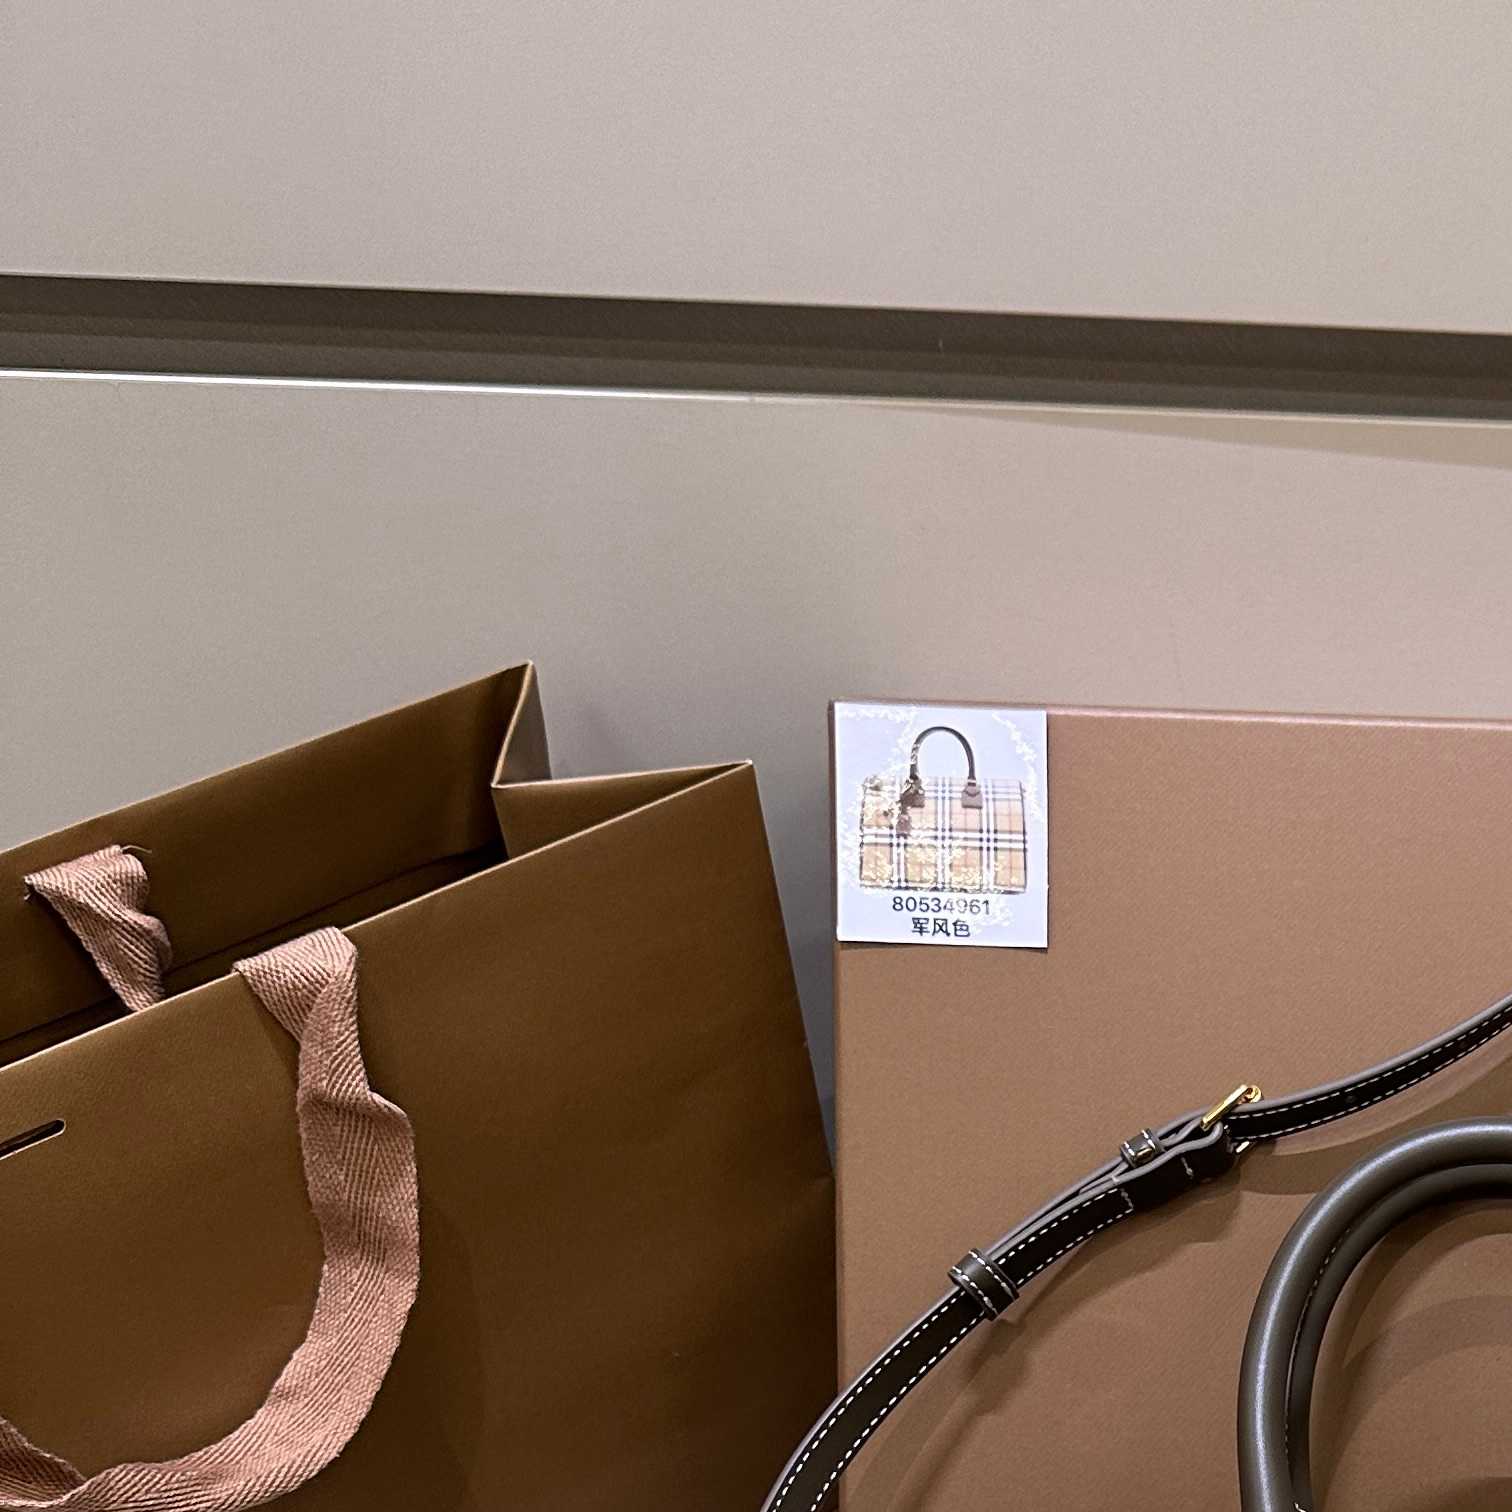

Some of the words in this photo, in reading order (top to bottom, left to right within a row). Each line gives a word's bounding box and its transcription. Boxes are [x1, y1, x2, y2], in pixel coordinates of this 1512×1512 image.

[892, 896, 990, 915] 80534961
[911, 917, 971, 938] 军风色
